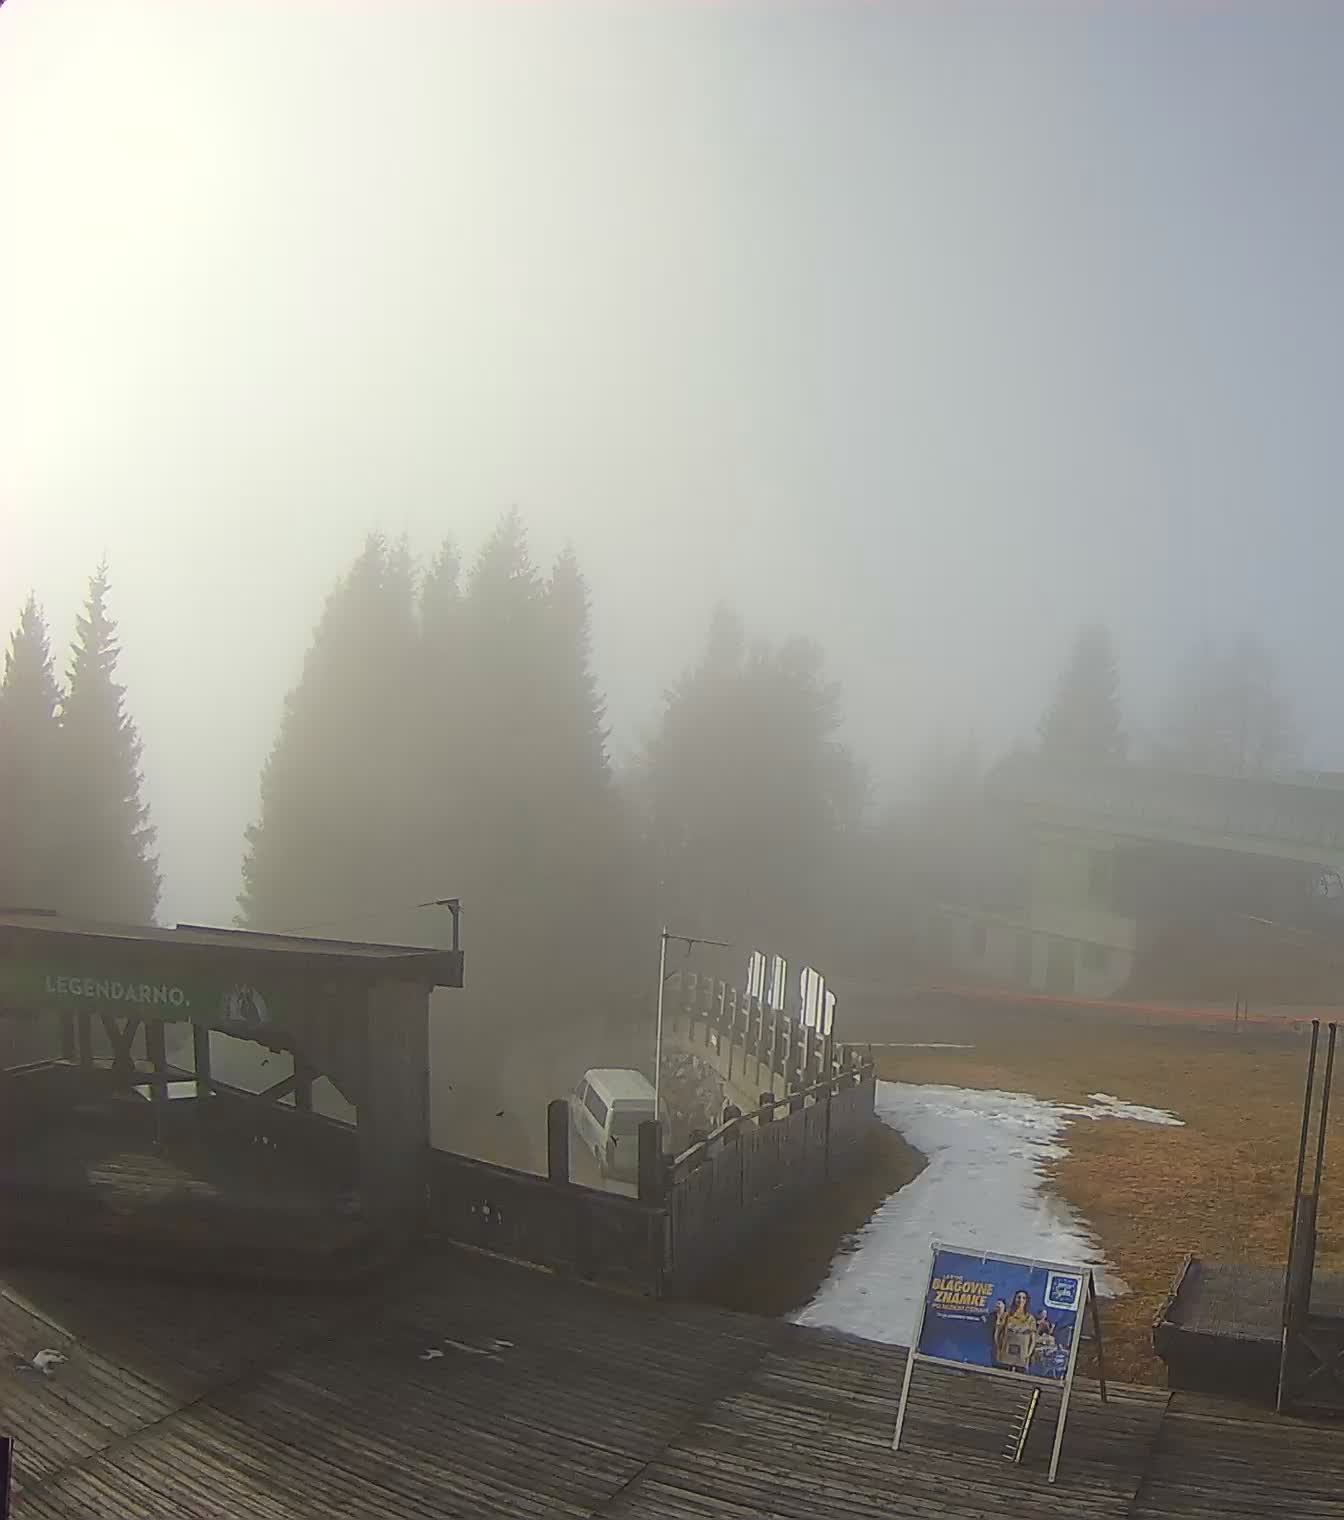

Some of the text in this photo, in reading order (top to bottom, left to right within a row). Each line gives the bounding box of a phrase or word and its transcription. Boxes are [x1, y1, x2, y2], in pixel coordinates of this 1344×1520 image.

[46, 975, 190, 1007] LEGENDARNO.
[932, 1278, 993, 1296] BLAGOVNE
[934, 1291, 987, 1307] ZNAMKE
